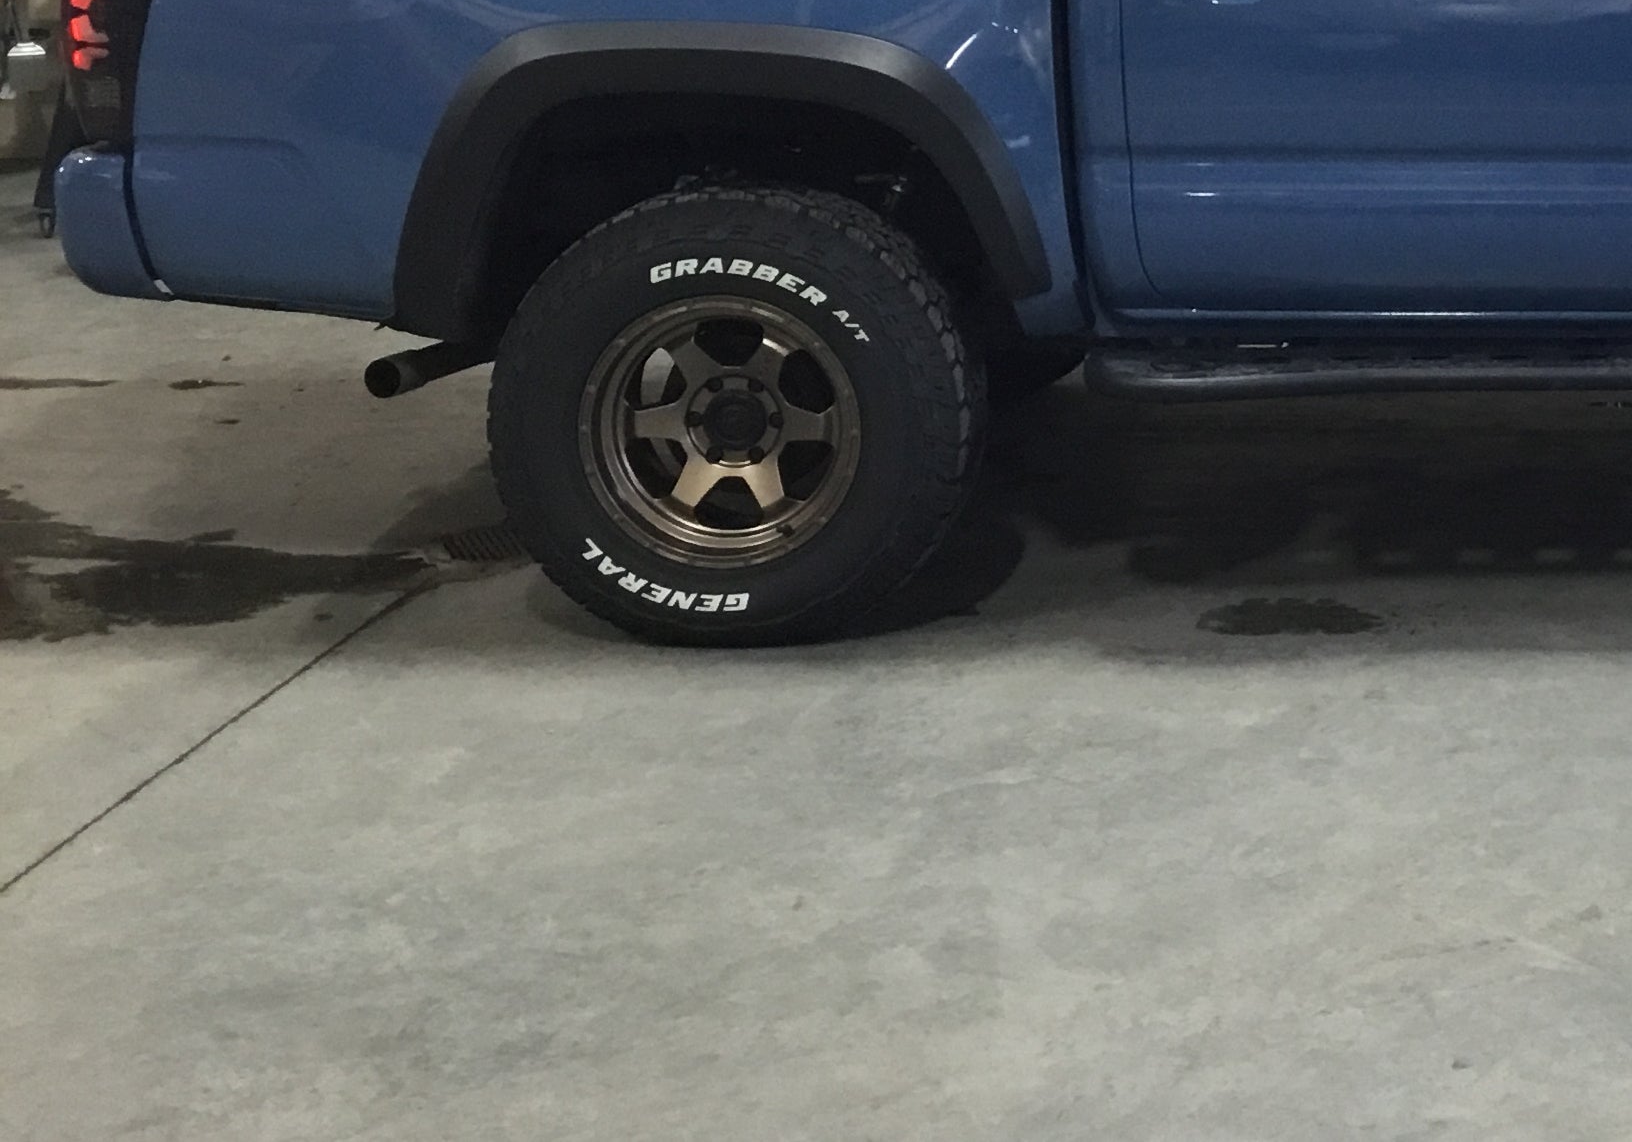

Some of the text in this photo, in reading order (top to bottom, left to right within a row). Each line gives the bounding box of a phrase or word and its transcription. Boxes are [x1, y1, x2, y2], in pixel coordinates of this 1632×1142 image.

[649, 257, 870, 343] GRABBER A/T
[581, 537, 751, 613] GENERAL
